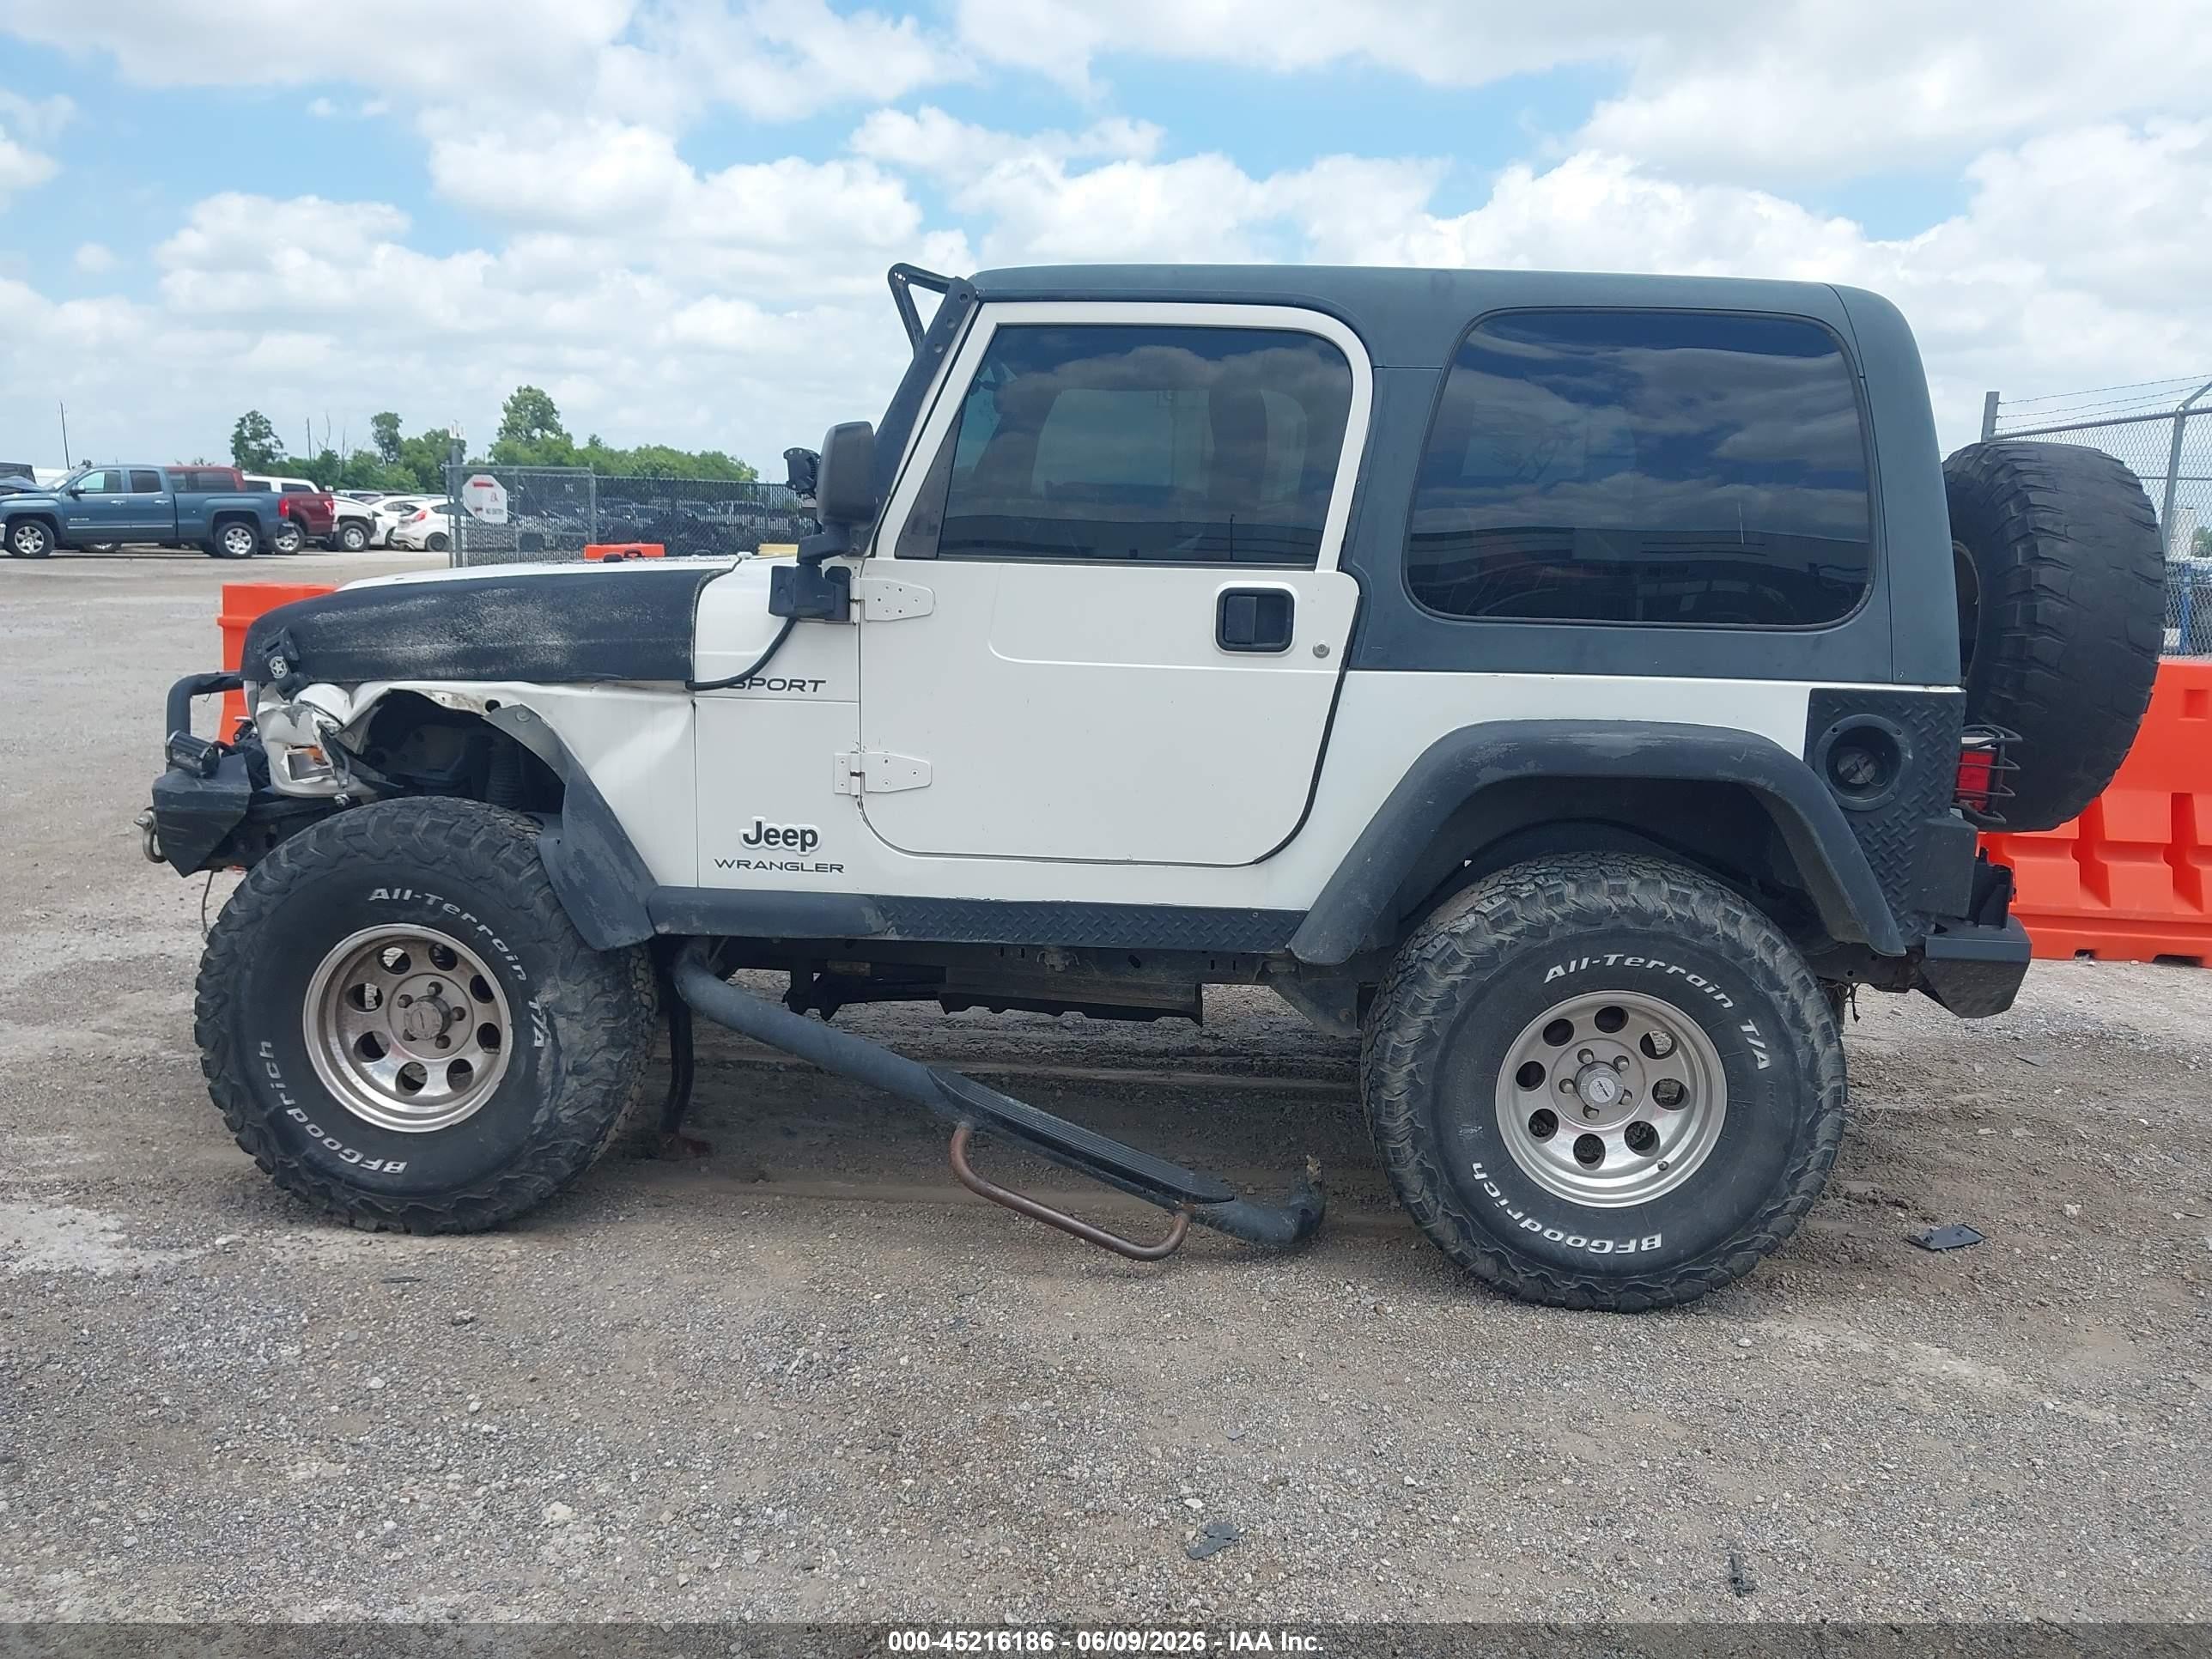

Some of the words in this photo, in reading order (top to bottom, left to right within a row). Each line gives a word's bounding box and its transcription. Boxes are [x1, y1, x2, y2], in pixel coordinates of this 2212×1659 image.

[714, 858, 845, 874] WRANGLER
[743, 821, 819, 853] Jeep
[368, 887, 527, 981] All-Terrain
[1543, 953, 1734, 1009] All-Terrain
[1738, 1018, 1771, 1070] T/A
[258, 1041, 408, 1176] BFGoodrich
[1469, 1162, 1662, 1255] BFGoodrich
